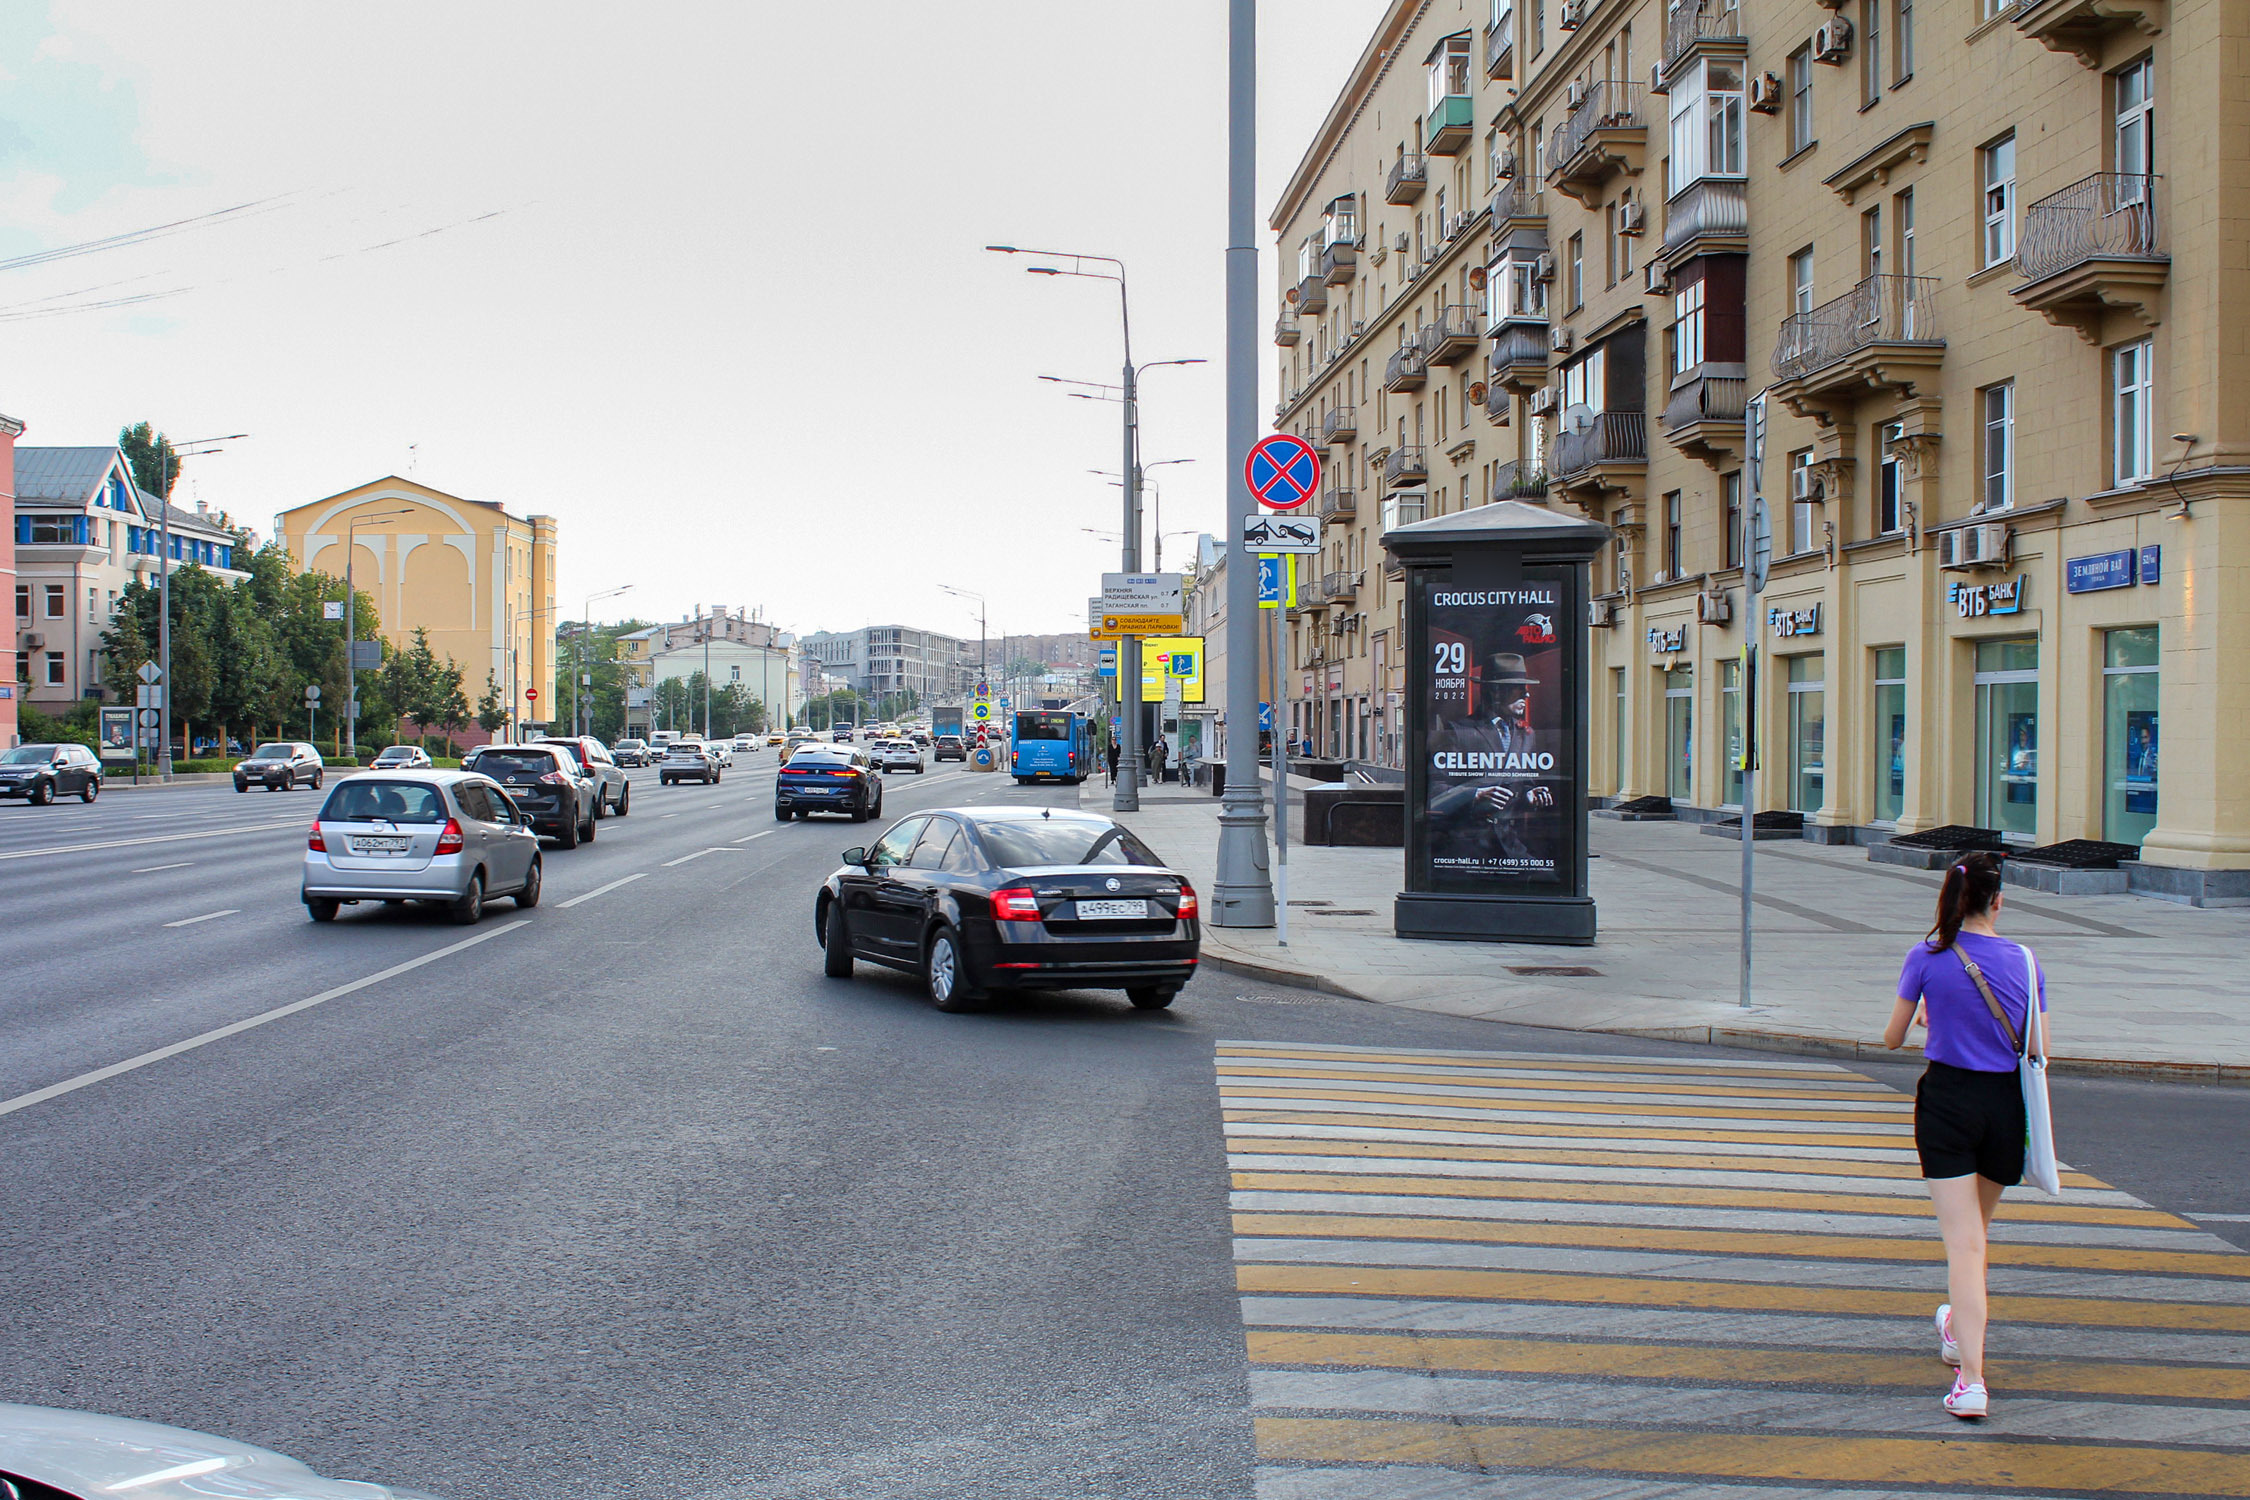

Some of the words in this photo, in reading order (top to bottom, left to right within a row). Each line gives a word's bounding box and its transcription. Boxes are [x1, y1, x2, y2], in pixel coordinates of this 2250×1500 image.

[2073, 559, 2109, 578] ЗЕМЛЯНОЙ
[2110, 559, 2122, 572] ВАЛ
[1434, 591, 1486, 606] CROCUS
[1487, 590, 1517, 605] CITY
[1518, 590, 1555, 604] HALL
[1958, 586, 1985, 617] ВТБ
[1988, 582, 2014, 601] БАНК
[1514, 625, 1542, 636] АВТО
[1775, 611, 1793, 637] ВТБ
[1795, 609, 1812, 623] БАНК
[1522, 634, 1557, 643] РАДИО
[1652, 631, 1667, 653] ВТБ
[1667, 631, 1680, 642] БАНК
[1435, 642, 1465, 674] 29
[1435, 678, 1465, 689] НОЯБРЯ
[1433, 751, 1554, 770] CELENTANO
[1433, 857, 1480, 865] crocus-hall.ru
[1498, 858, 1519, 867] (499)
[1530, 859, 1544, 867] 000
[1545, 859, 1555, 867] 55
